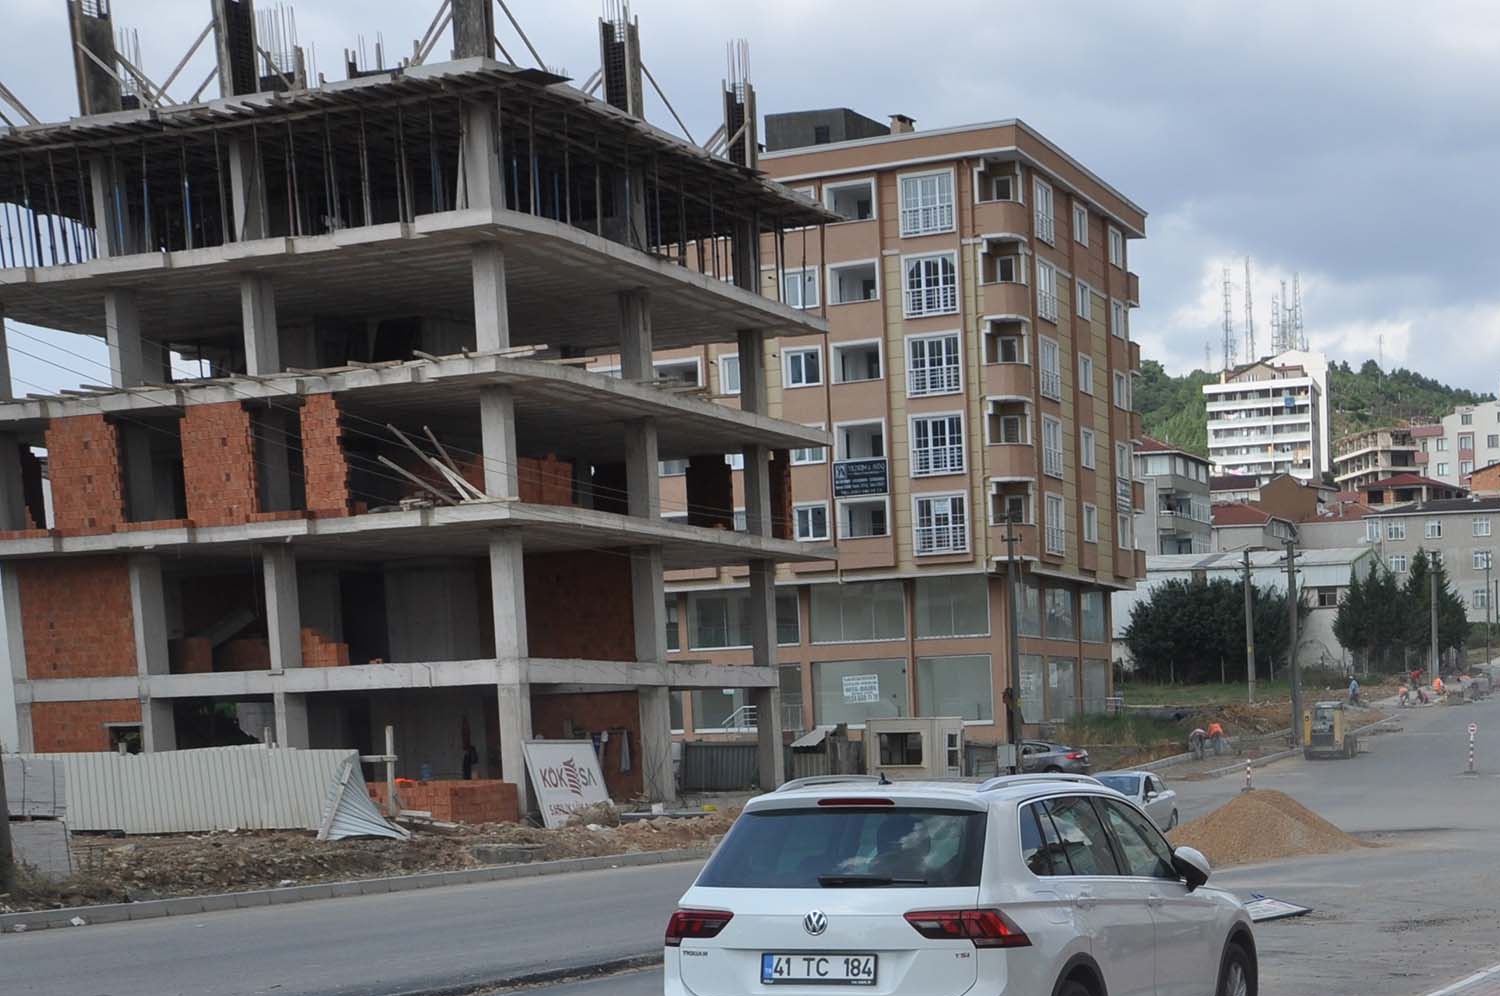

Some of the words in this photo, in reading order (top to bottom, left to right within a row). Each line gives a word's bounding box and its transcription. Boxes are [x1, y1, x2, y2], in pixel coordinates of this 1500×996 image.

[773, 957, 791, 977] 41
[802, 957, 829, 977] TC
[843, 957, 873, 977] 184
